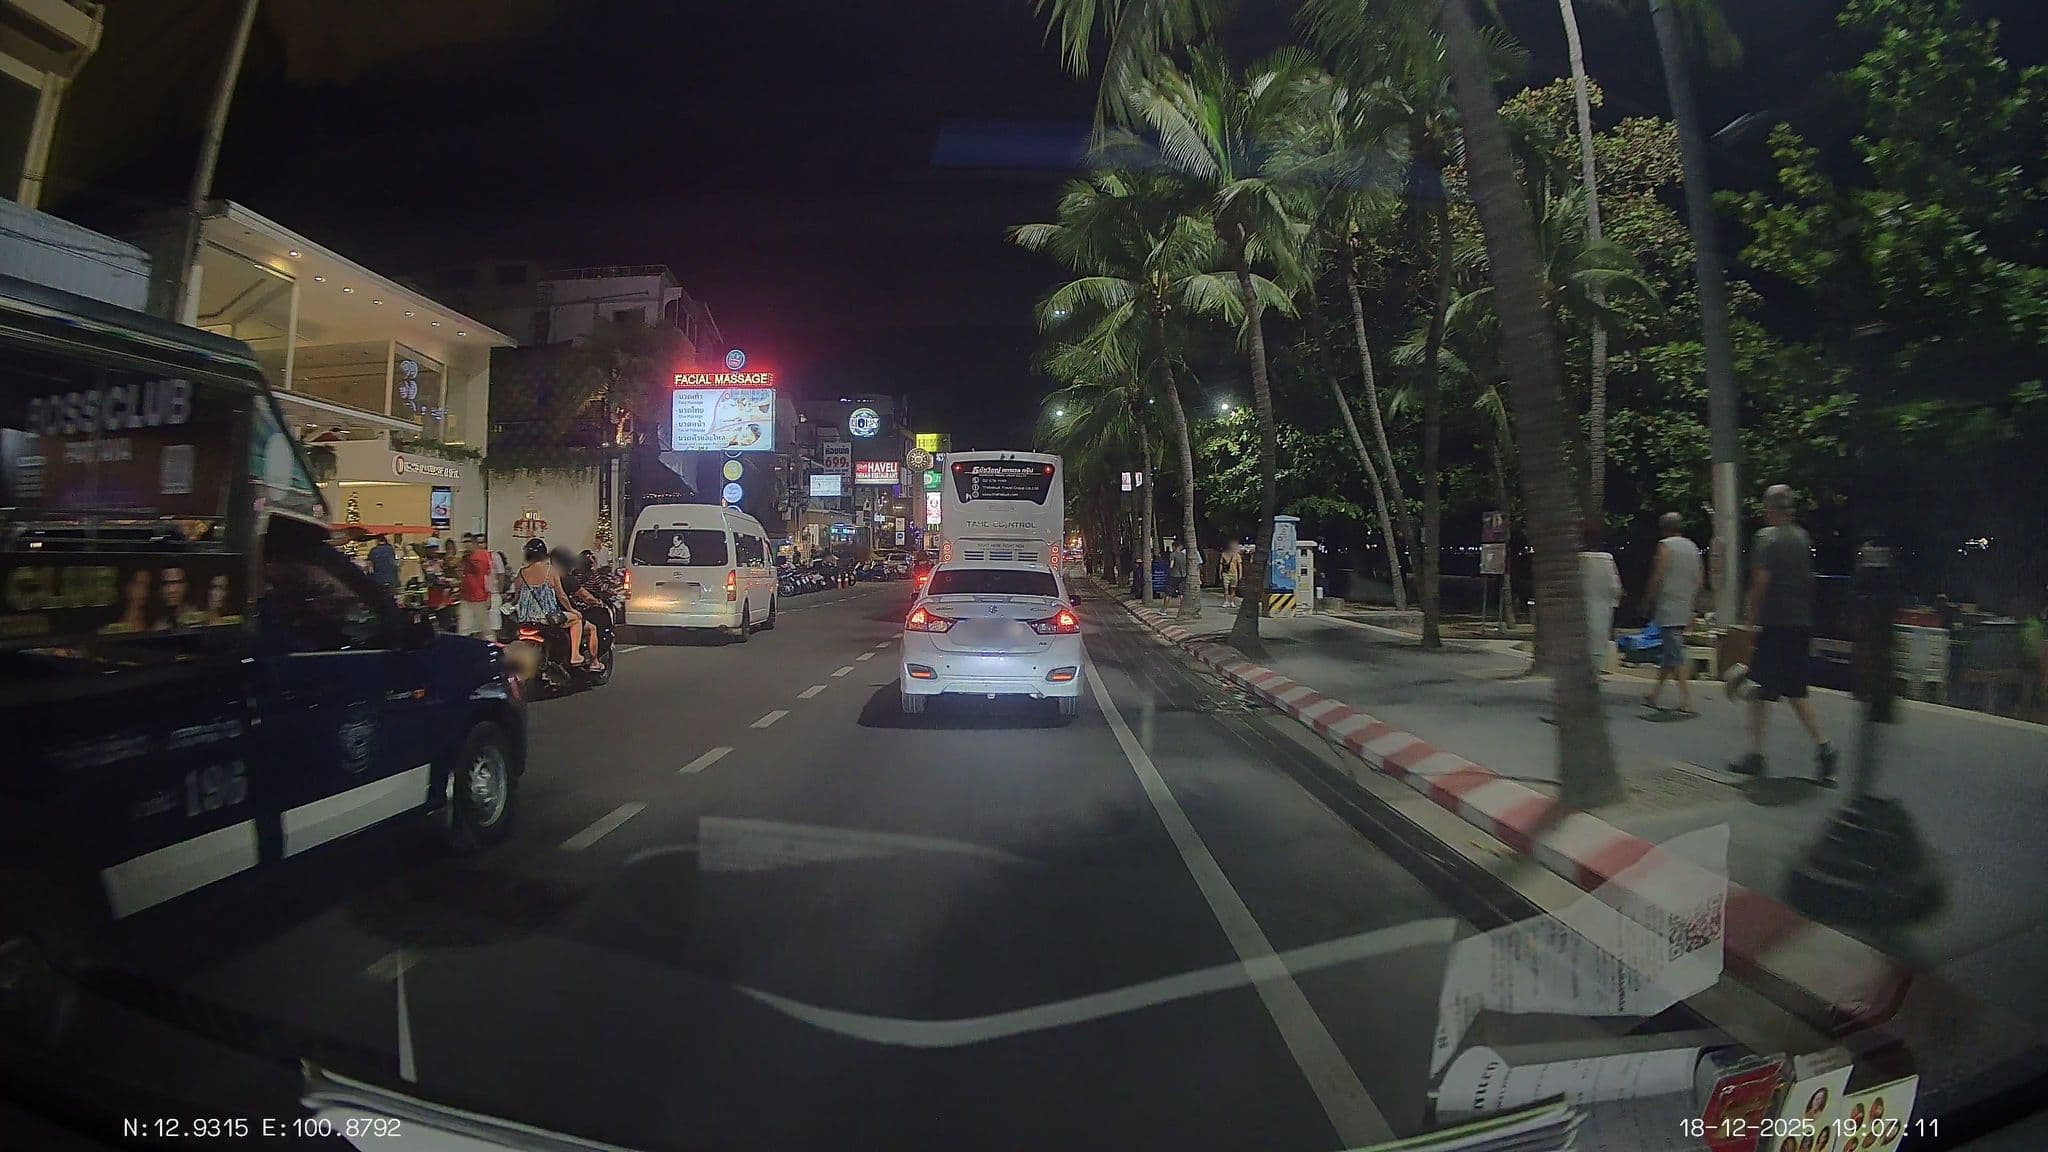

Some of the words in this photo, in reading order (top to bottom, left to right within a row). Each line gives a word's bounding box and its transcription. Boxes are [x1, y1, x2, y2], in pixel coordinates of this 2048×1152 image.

[675, 374, 711, 385] FACIAL
[714, 374, 768, 384] MASSAGE
[867, 461, 897, 472] HAVELI
